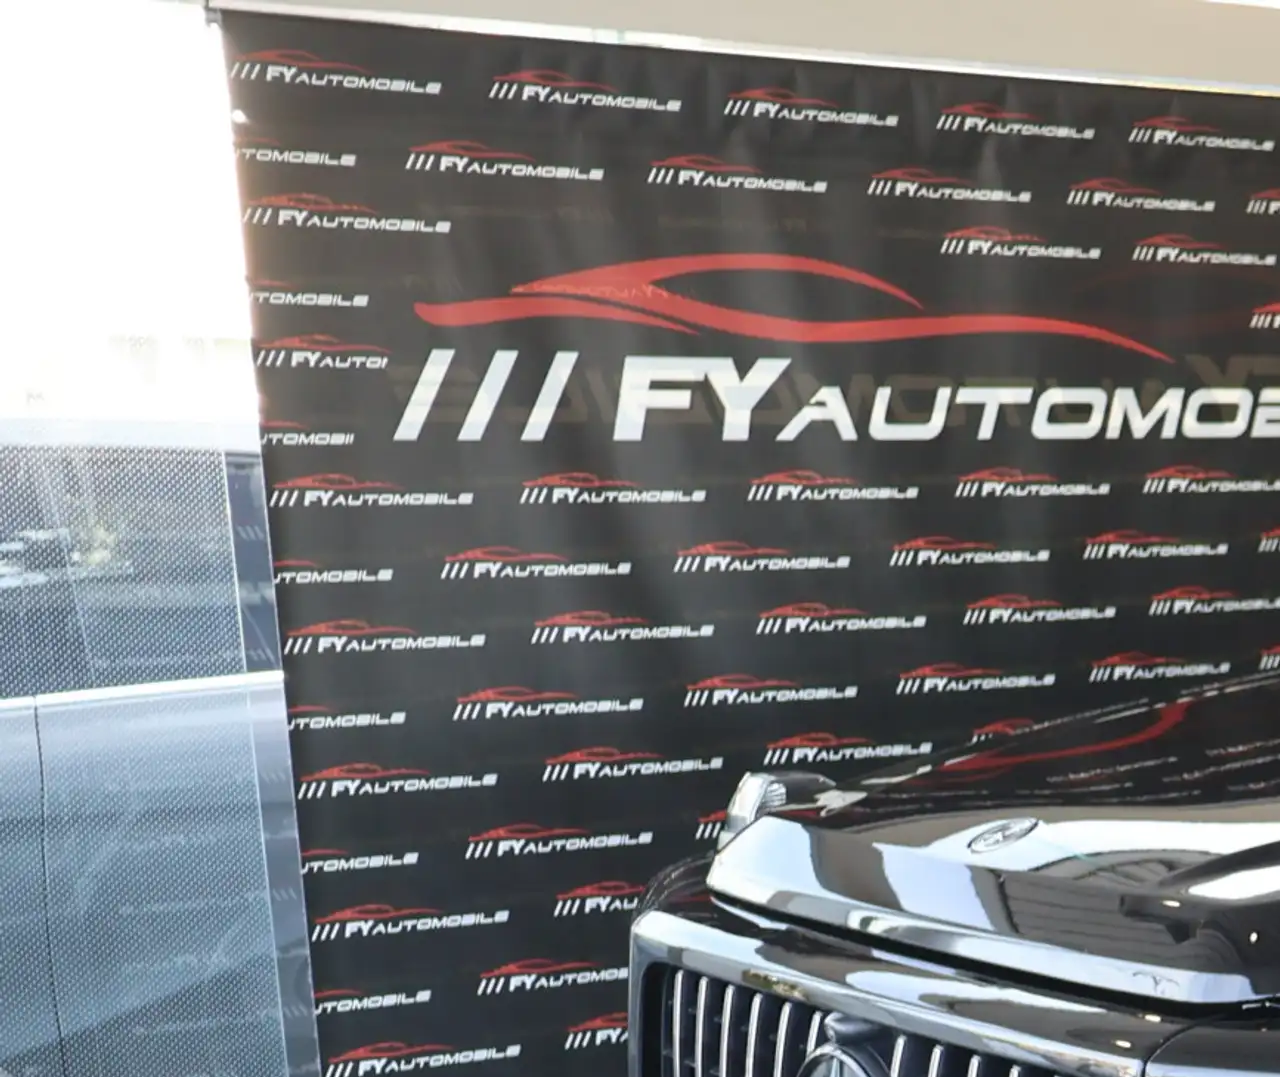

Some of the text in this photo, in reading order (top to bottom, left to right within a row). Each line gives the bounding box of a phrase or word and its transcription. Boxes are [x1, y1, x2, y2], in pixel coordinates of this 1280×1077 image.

[266, 65, 442, 94] FYAUTOMOBILE
[522, 84, 681, 112] FYAUTOMOBILE
[753, 101, 899, 126] FYAUTOMOBILE
[960, 116, 1095, 139] FYAUTOMOBILE
[1150, 129, 1275, 151] FYAUTOMOBILE
[439, 156, 604, 180] FYAUTOMOBILE
[678, 170, 827, 193] FYAUTOMOBILE
[894, 181, 1031, 202] FYAUTOMOBILE
[1092, 191, 1215, 211] FYAUTOMOBILE
[278, 209, 451, 233] FYAUTOMOBILE
[967, 235, 1101, 259] FYAUTOMOBILE
[1156, 247, 1277, 265] FYAUTOMOBILE
[552, 487, 706, 503] FYAUTOMOBILE
[776, 481, 919, 501] FYAUTOMOBILE
[981, 477, 1110, 497] FYAUTOMOBILE
[304, 490, 473, 507] FYAUTOMOBILE
[913, 545, 1050, 566] FYAUTOMOBILE
[1107, 542, 1228, 559] FYAUTOMOBILE
[473, 562, 631, 578] FYAUTOMOBILE
[704, 554, 850, 572] FYAUTOMOBILE
[785, 608, 927, 633] FYAUTOMOBILE
[989, 606, 1116, 624] FYAUTOMOBILE
[318, 634, 486, 653] FYAUTOMOBILE
[563, 625, 714, 643] FYAUTOMOBILE
[923, 674, 1055, 693] FYAUTOMOBILE
[1112, 662, 1230, 685] FYAUTOMOBILE
[712, 679, 858, 705] FYAUTOMOBILE
[485, 698, 644, 719] FYAUTOMOBILE
[792, 740, 932, 767] FYAUTOMOBILE
[573, 757, 723, 780] FYAUTOMOBILE
[331, 769, 498, 797] FYAUTOMOBILE
[497, 830, 653, 857] FYAUTOMOBILE
[341, 910, 509, 938] FYAUTOMOBILE
[358, 1044, 521, 1077] FYAUTOMOBILE
